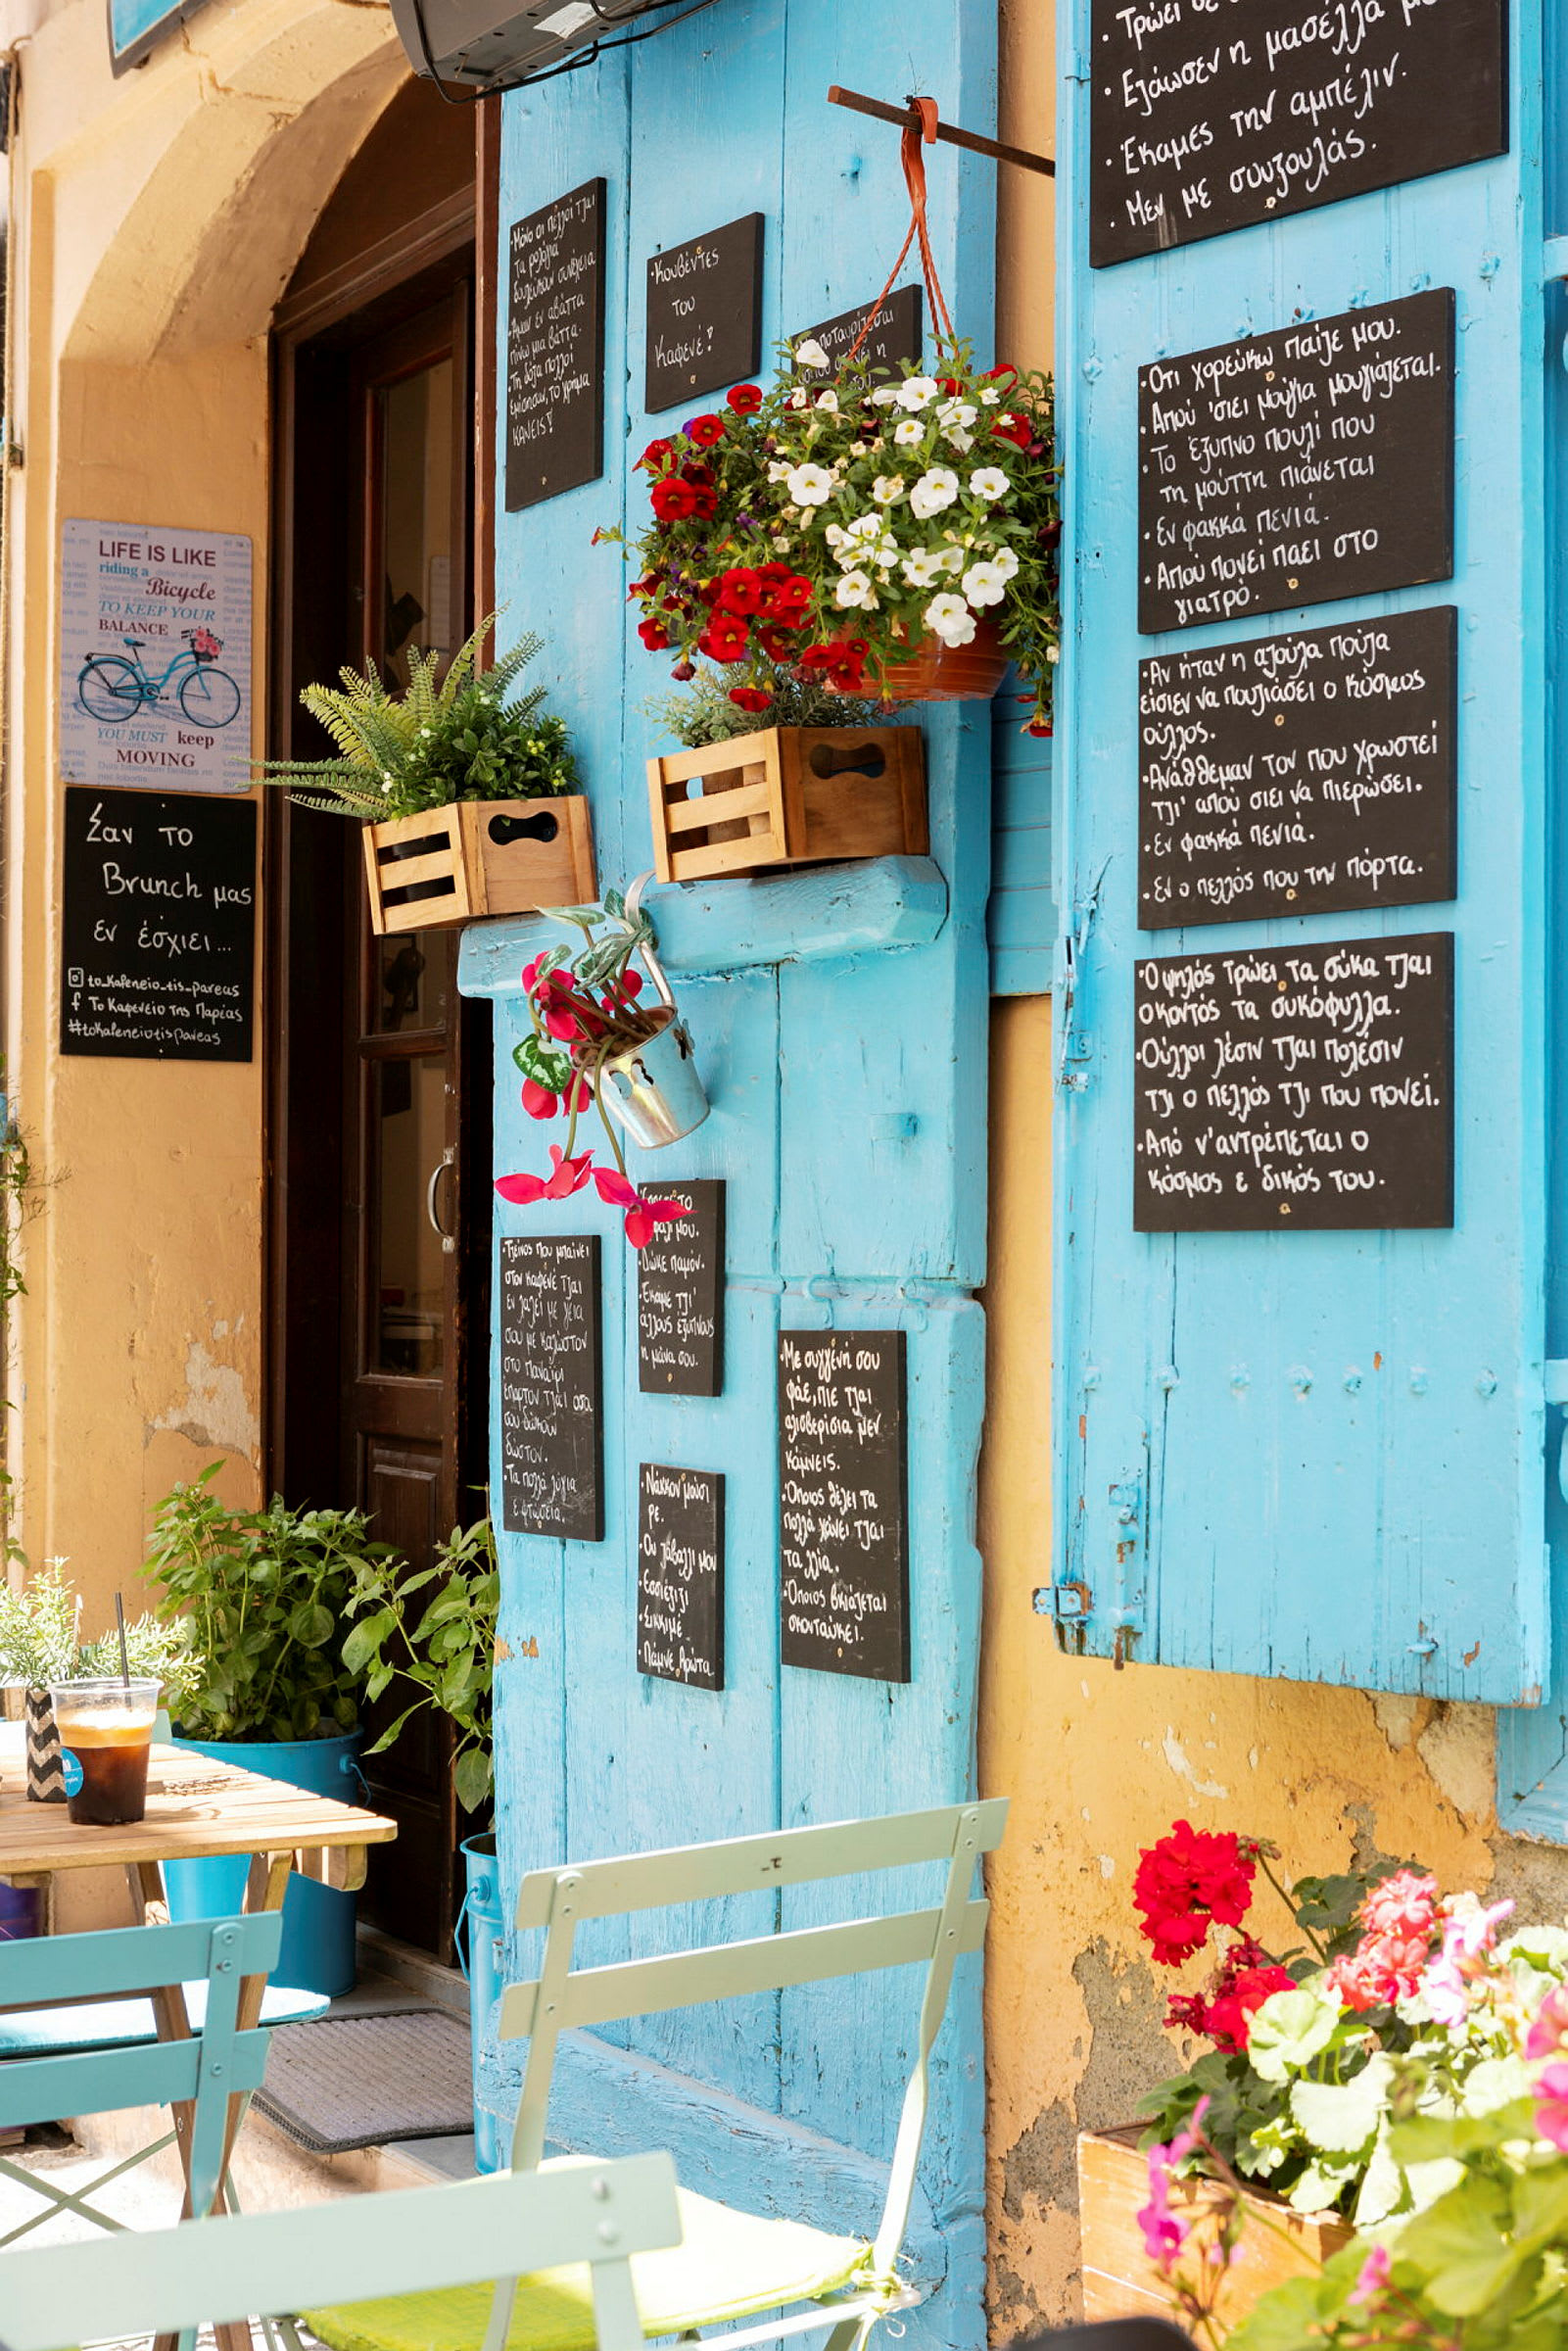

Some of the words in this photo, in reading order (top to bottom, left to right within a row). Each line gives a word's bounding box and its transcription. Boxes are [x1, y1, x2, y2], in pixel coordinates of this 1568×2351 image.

[1229, 40, 1252, 65] η
[1229, 89, 1276, 137] την
[1182, 178, 1212, 218] με
[1150, 446, 1176, 475] Το
[1332, 413, 1375, 439] που
[1160, 487, 1188, 504] τη
[1280, 455, 1374, 488] πιάνεται
[99, 540, 141, 560] LIFE
[148, 545, 166, 561] IS
[172, 548, 216, 567] LIKE
[1211, 539, 1265, 579] πονεί
[1334, 529, 1378, 558] στο
[99, 562, 137, 578] riding
[145, 577, 216, 604] Bicycle
[99, 600, 119, 612] TO
[124, 603, 166, 618] KEEP
[170, 607, 215, 621] YOUR
[99, 619, 168, 636] BALANCE
[1150, 661, 1171, 686] Αν
[1232, 653, 1246, 672] η
[1198, 687, 1219, 709] να
[1324, 682, 1337, 698] ο
[98, 728, 125, 741] YOU
[128, 730, 168, 744] MUST
[177, 731, 214, 747] keep
[117, 749, 196, 767] MOVING
[1262, 749, 1296, 776] τον
[1308, 746, 1347, 771] που
[1291, 780, 1313, 804] να
[103, 862, 202, 898] Brunch
[214, 887, 252, 908] μας
[1179, 882, 1190, 896] ο
[1264, 870, 1299, 890] που
[1305, 863, 1335, 885] την
[1286, 960, 1318, 982] τα
[1324, 949, 1379, 982] σύκα
[1232, 1001, 1259, 1020] τα
[1183, 1089, 1197, 1108] ο
[1322, 1084, 1360, 1107] που
[1146, 1128, 1182, 1157] Από
[1352, 1130, 1369, 1151] ο
[1262, 1163, 1320, 1193] δικός
